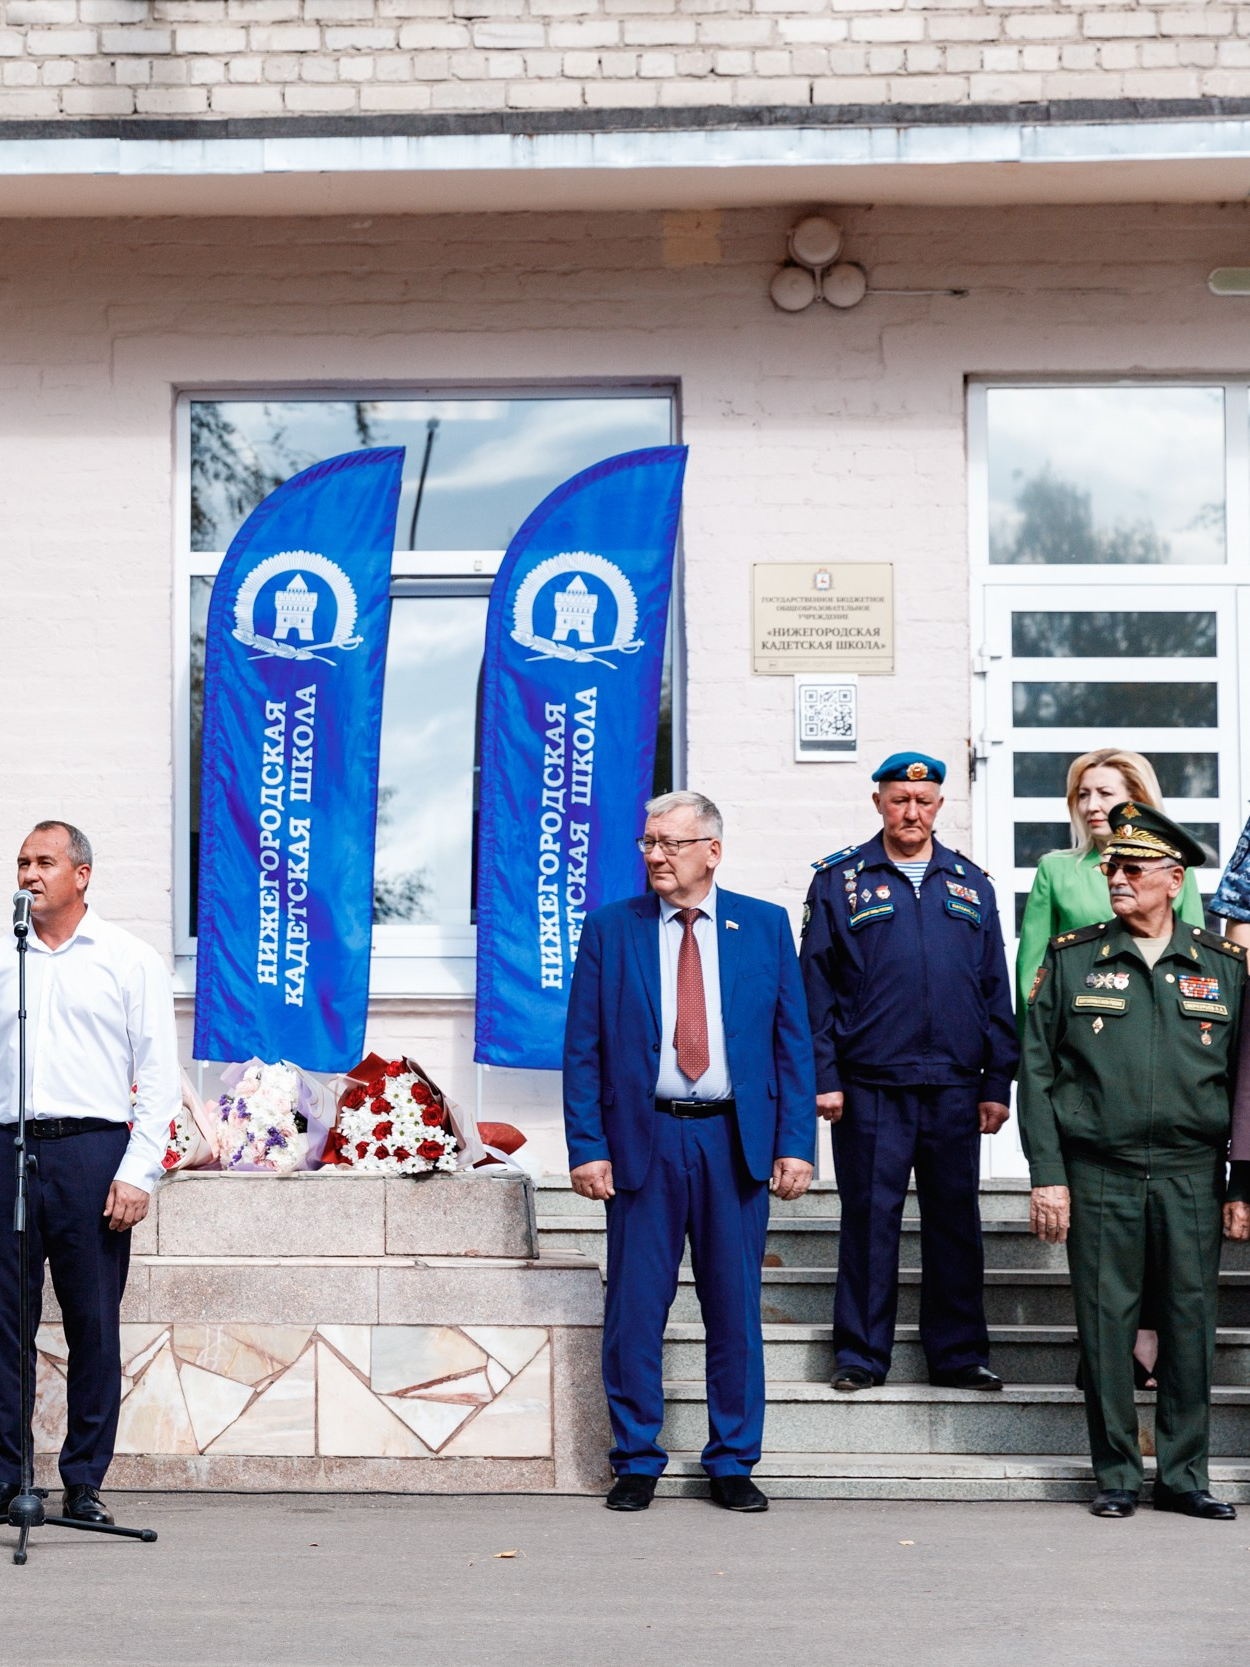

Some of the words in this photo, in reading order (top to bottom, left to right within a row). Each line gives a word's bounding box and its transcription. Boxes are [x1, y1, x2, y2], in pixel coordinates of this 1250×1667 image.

[761, 596, 833, 604] ГОСУДАРСТВЕННОЕ
[836, 596, 884, 604] БЮДЖЕТНОЕ
[761, 640, 833, 651] КАДЕТСКАЯ
[836, 640, 886, 650] ШКОЛА»
[767, 627, 880, 638] «НИЖЕГОРОДСКАЯ
[289, 684, 317, 803] ШКОЛА
[571, 686, 597, 806] ШКОЛА
[257, 700, 286, 986] НИЖЕГОРОДСКАЯ
[537, 702, 567, 990] НИЖЕГОРОДСКАЯ
[284, 816, 311, 1007] КАДЕТСКАЯ
